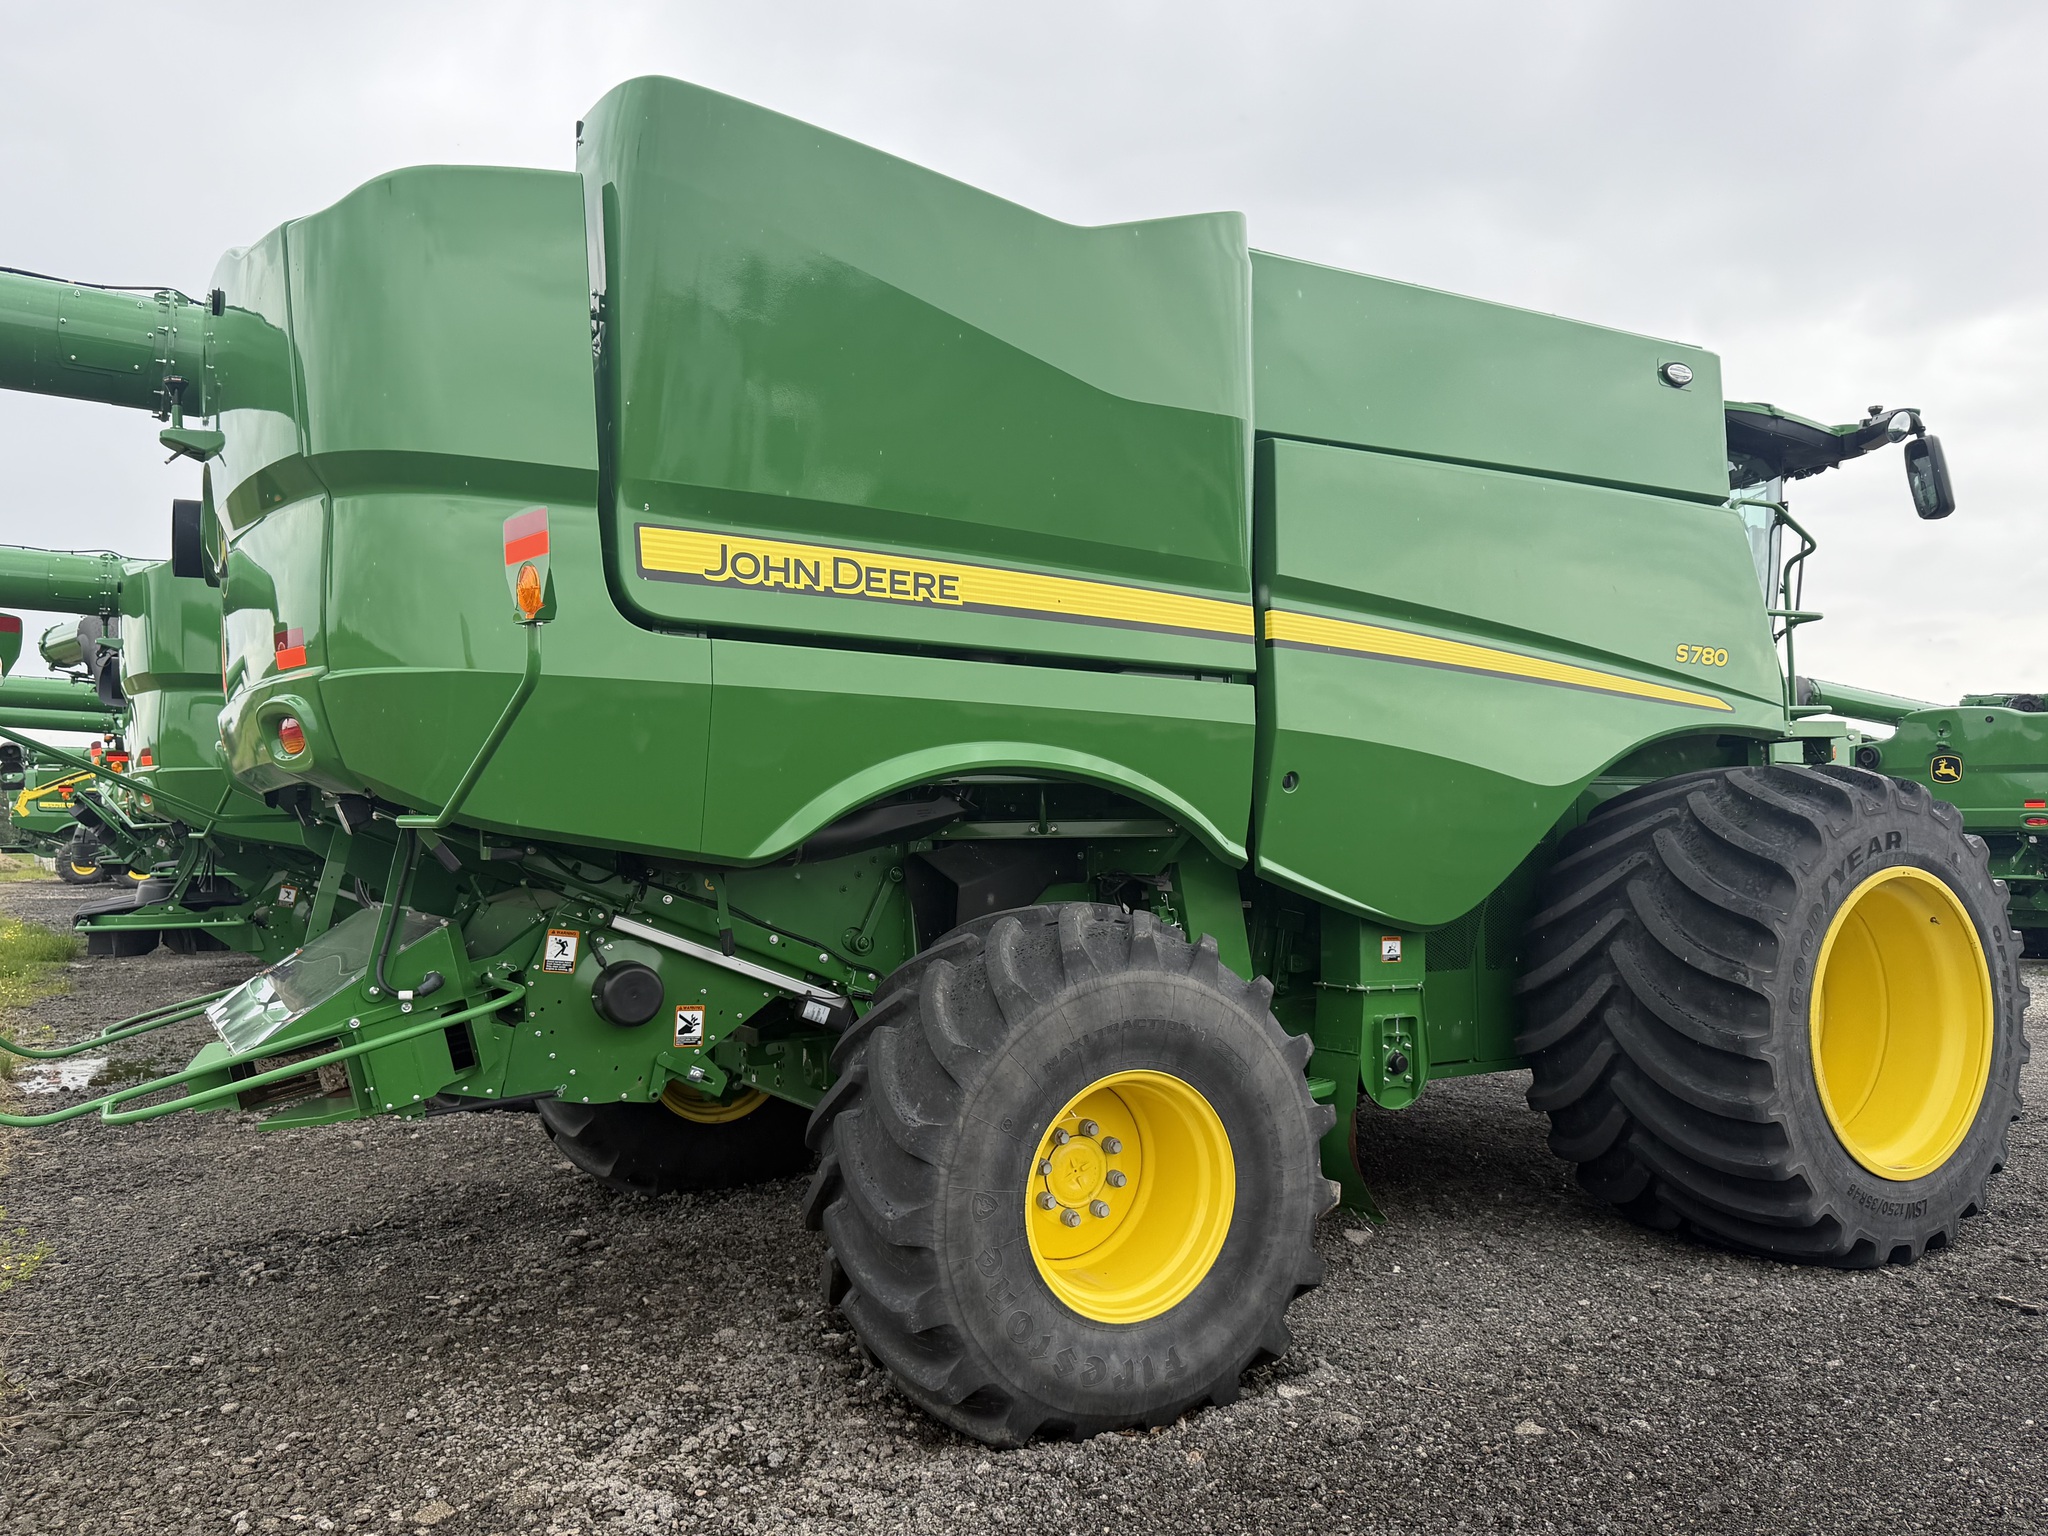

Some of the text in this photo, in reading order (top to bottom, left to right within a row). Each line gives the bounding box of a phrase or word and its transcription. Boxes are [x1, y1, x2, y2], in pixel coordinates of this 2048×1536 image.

[704, 543, 962, 604] JOHN DEERE
[1675, 643, 1729, 667] S780
[1993, 925, 2013, 1082] OPTITRAC
